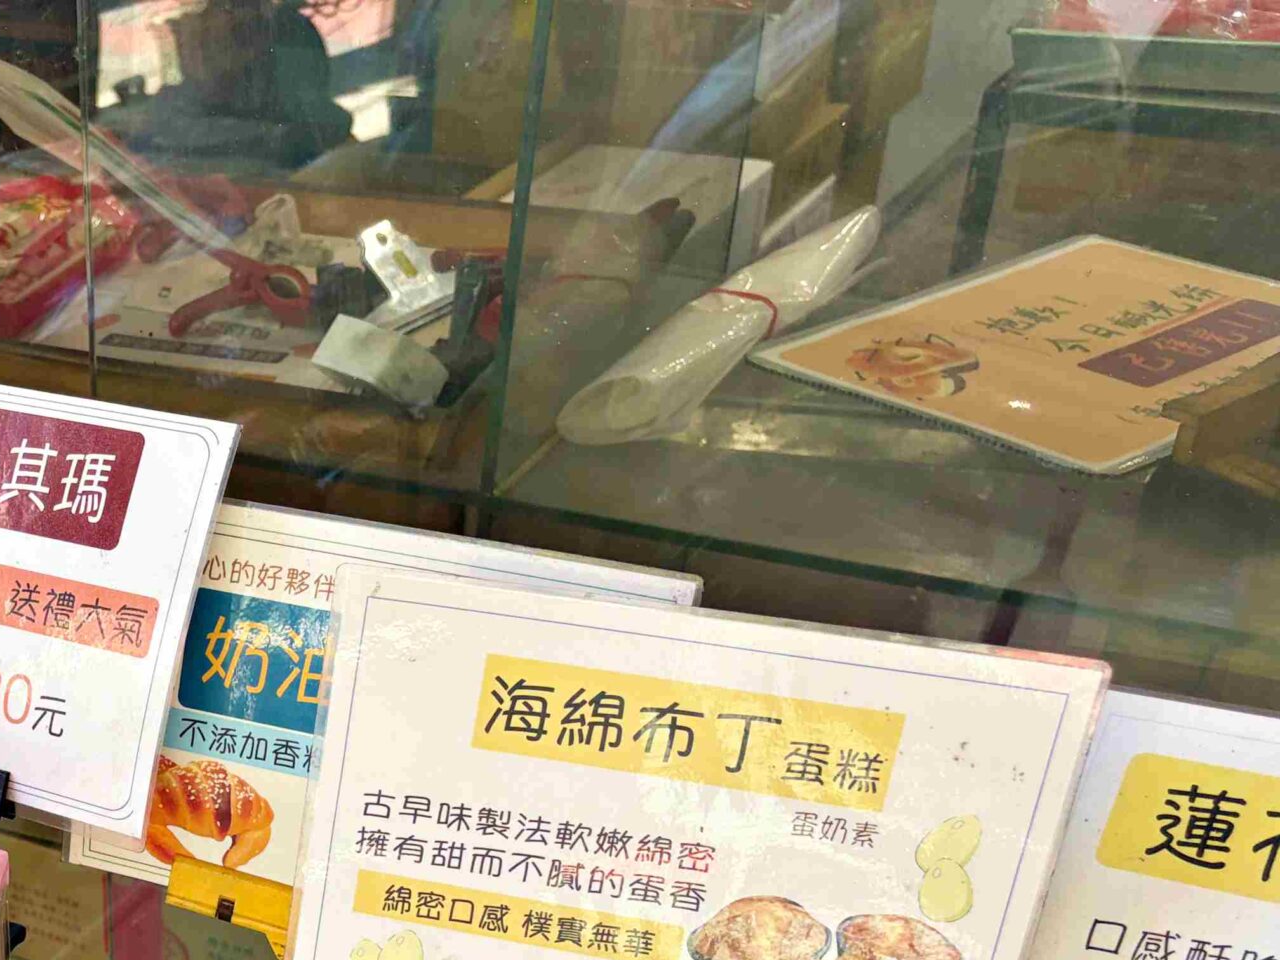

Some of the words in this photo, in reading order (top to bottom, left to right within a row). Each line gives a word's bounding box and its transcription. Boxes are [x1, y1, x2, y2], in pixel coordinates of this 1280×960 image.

[7, 579, 150, 649] 送禮大氣
[202, 554, 336, 603] 心的好夥伴
[362, 789, 717, 874] 古早味製法軟嫩綿密
[790, 810, 882, 851] 蛋奶素
[355, 825, 709, 914] 擁有甜而不膩的蛋香
[381, 883, 512, 935] 綿密口感
[520, 908, 658, 960] 樸實無華
